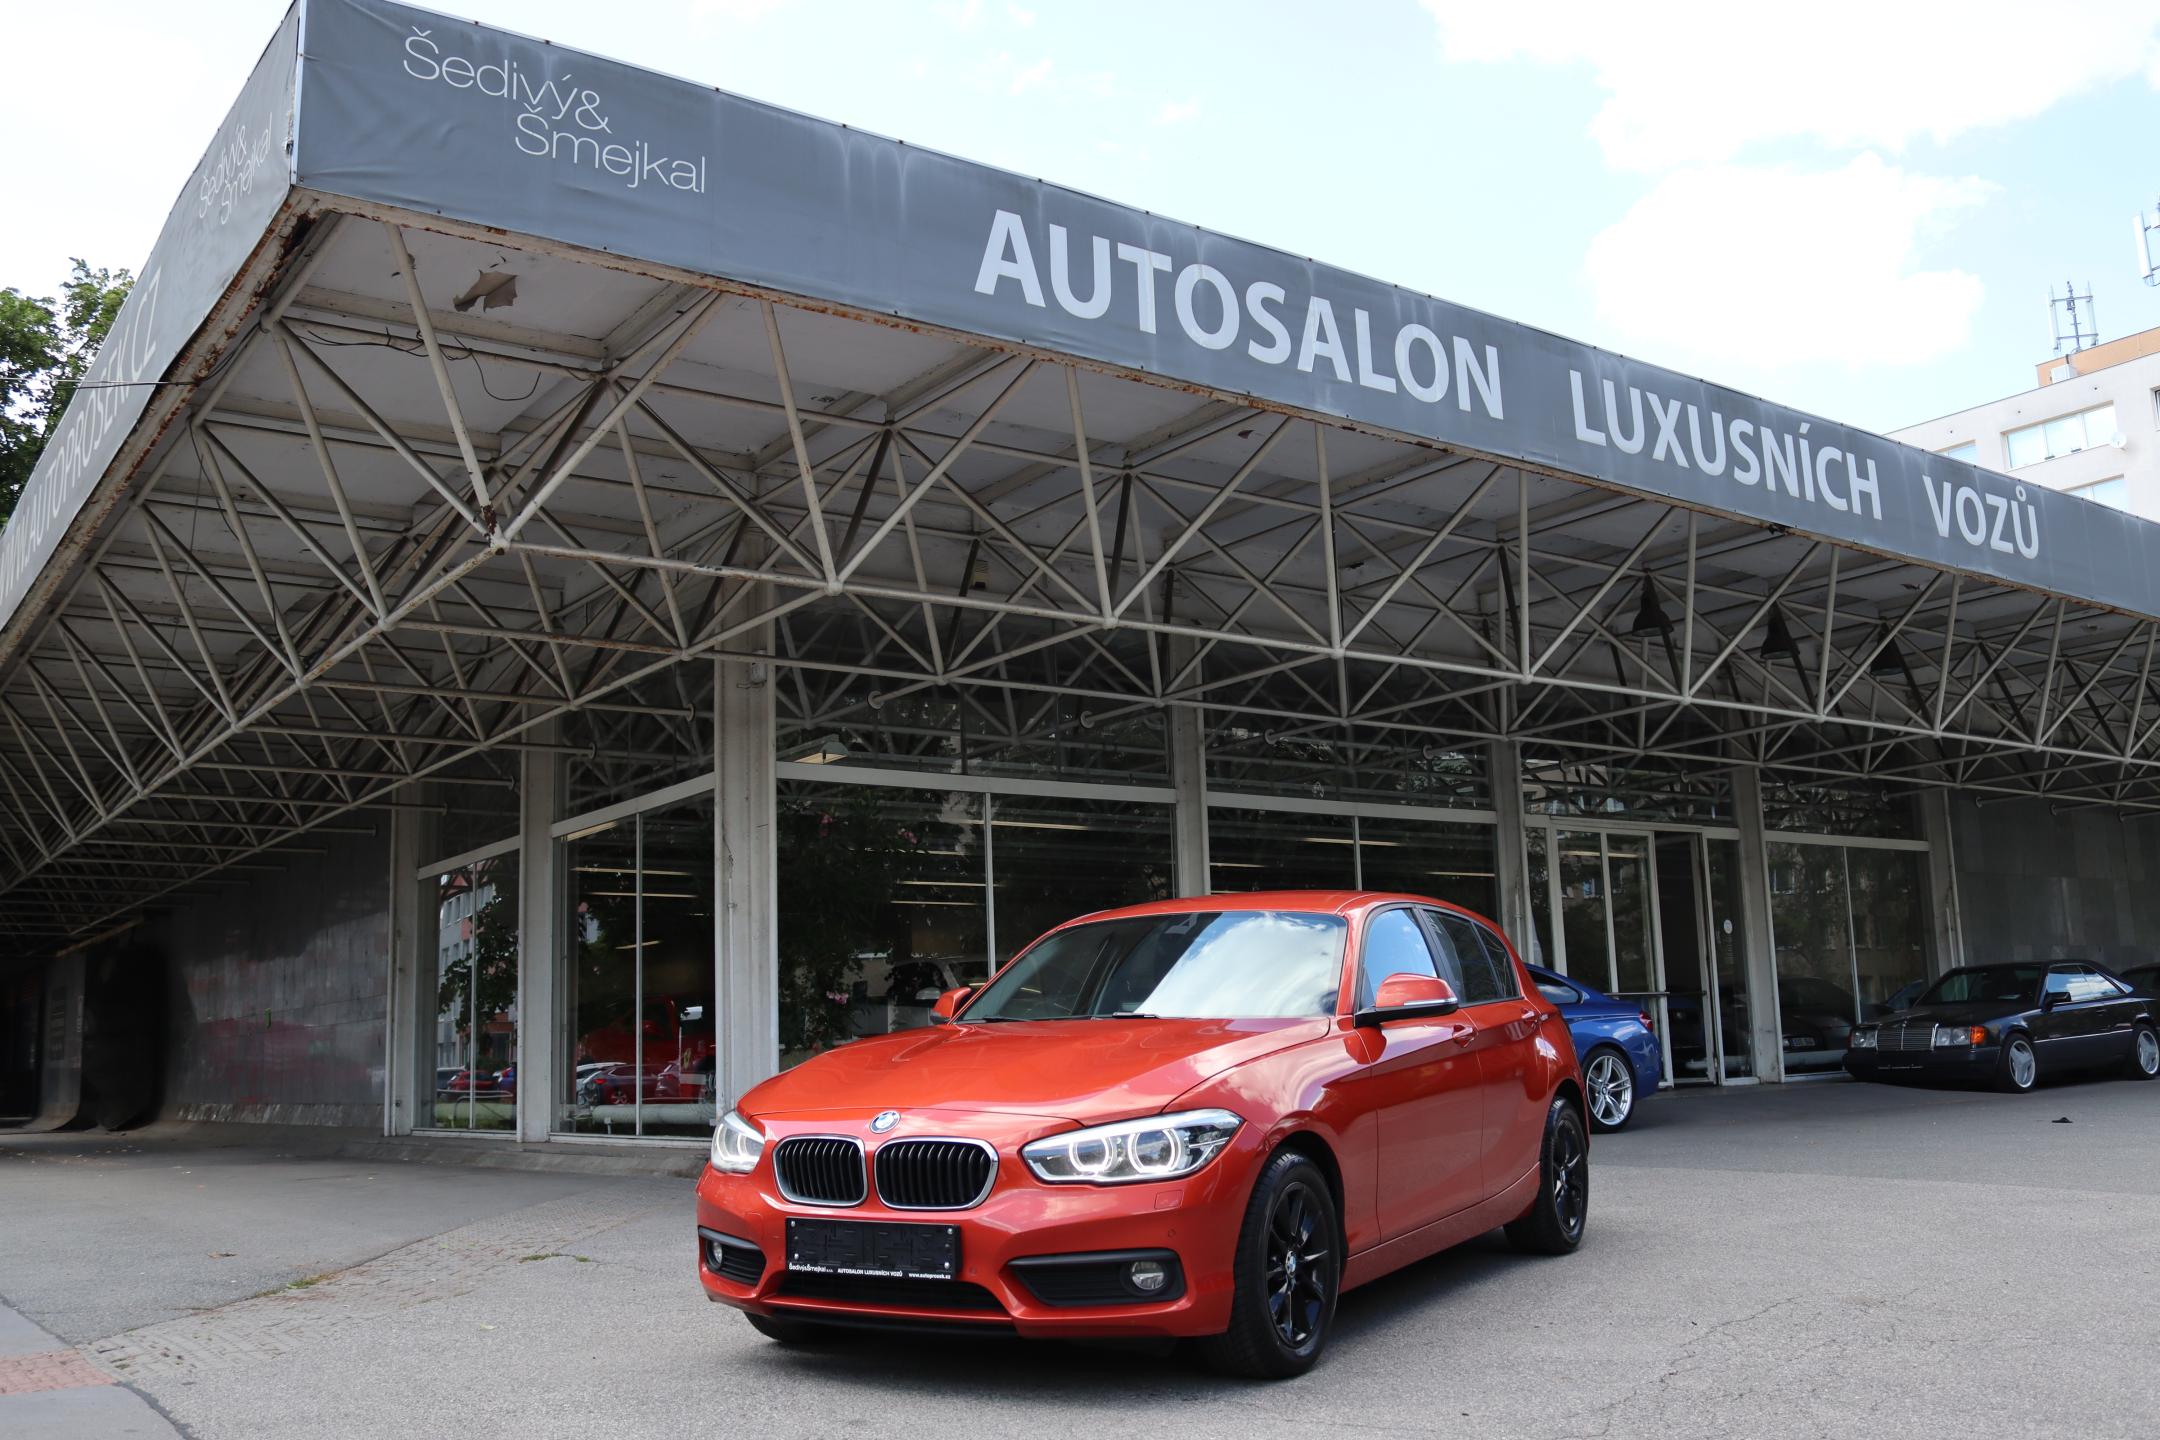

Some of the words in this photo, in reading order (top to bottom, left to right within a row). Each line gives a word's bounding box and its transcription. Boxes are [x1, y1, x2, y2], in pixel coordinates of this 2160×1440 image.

[403, 25, 612, 134] Šedivý&
[199, 124, 247, 218] Šedivý&
[220, 112, 272, 225] Šmejkal
[515, 102, 706, 194] Šmejkal
[974, 208, 1504, 420] AUTOSALON
[1569, 369, 1883, 521] LUXUSNÍCH
[1922, 484, 2040, 560] VOZŮ
